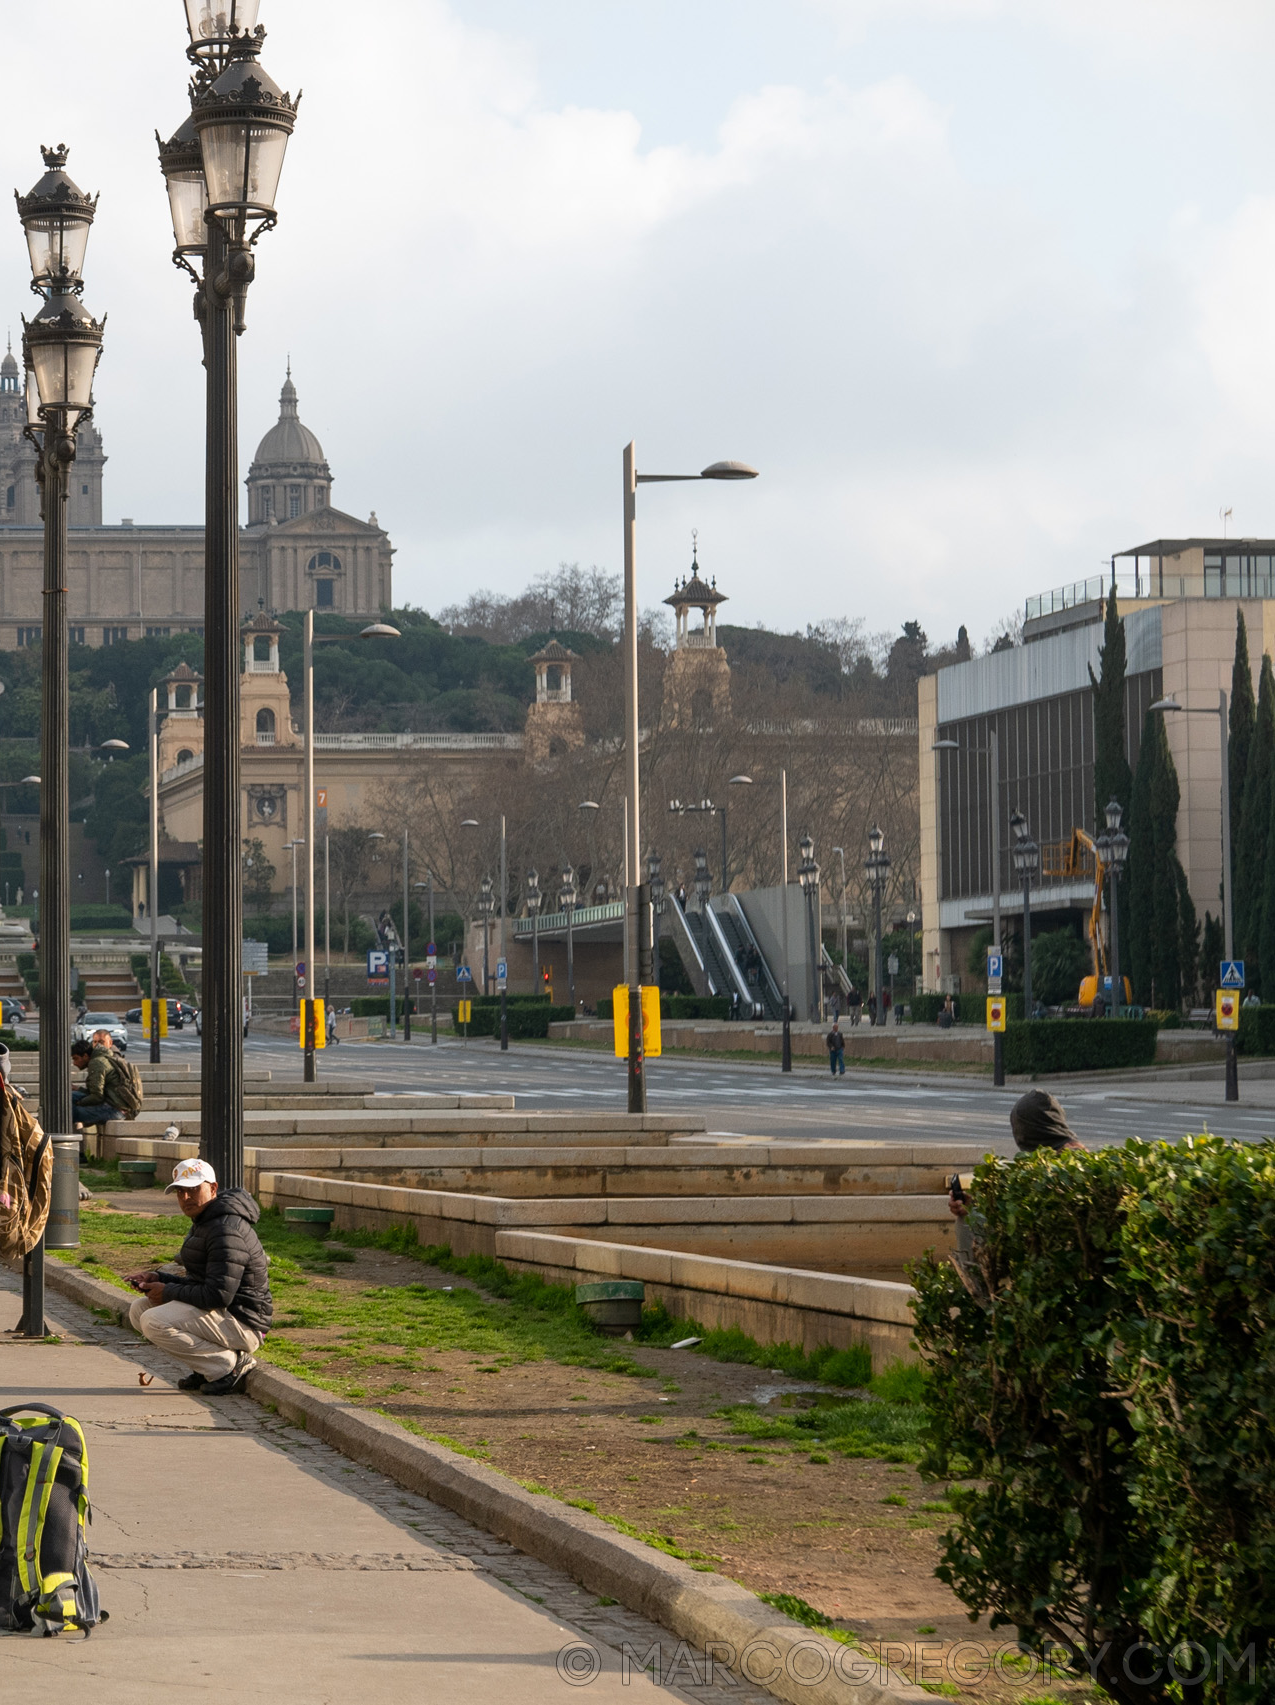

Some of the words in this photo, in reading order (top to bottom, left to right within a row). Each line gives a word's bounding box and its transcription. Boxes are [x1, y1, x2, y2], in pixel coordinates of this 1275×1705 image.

[369, 951, 387, 973] P
[498, 964, 505, 978] P
[990, 957, 998, 976] P
